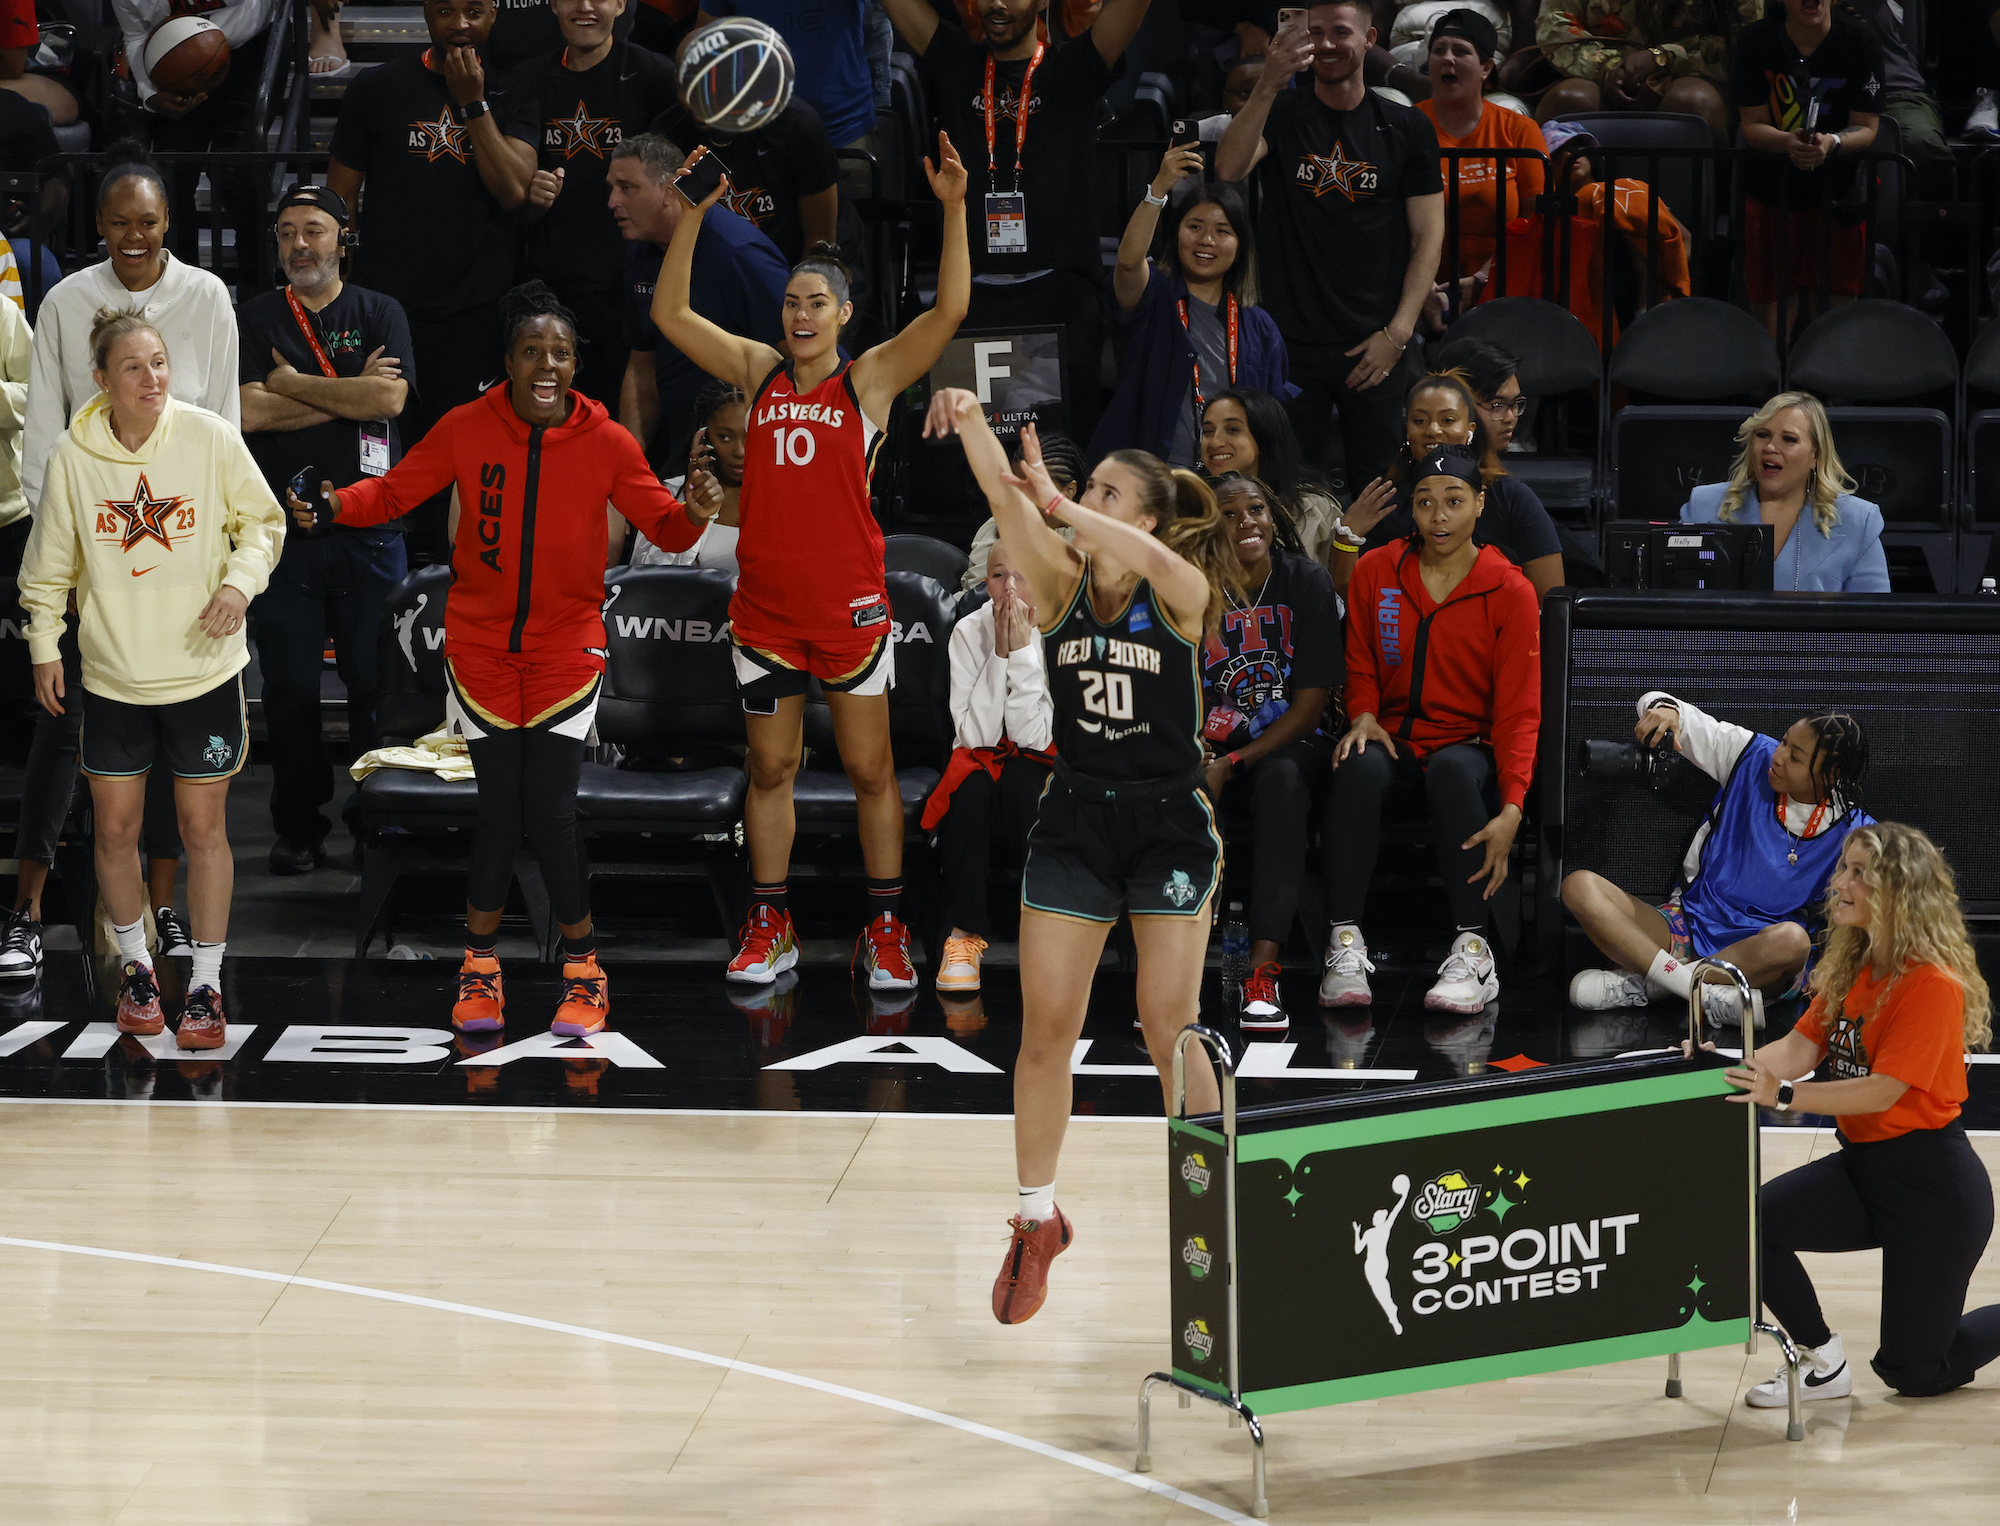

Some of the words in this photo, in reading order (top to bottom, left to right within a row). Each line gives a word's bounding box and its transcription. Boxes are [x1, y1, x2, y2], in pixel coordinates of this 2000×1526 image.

[408, 130, 427, 147] AS
[546, 129, 563, 145] AS
[605, 128, 623, 144] 23
[1297, 163, 1315, 181] AS
[1360, 172, 1378, 189] 23
[756, 195, 774, 212] 23
[974, 340, 1013, 403] F
[990, 426, 1016, 435] RENA
[1002, 412, 1038, 422] ULTRA
[773, 427, 816, 466] 10
[96, 513, 118, 534] AS
[176, 507, 195, 530] 23
[478, 462, 506, 574] ACES
[1378, 587, 1403, 666] DREAM
[1057, 636, 1092, 667] NEW
[1108, 638, 1161, 675] YORK
[1077, 670, 1134, 720] 20
[0, 1021, 667, 1069] NBA
[1836, 1058, 1869, 1077] STAR
[1181, 1155, 1211, 1191] Starry
[1413, 1183, 1479, 1220] Starry
[1183, 1238, 1212, 1274] Starry
[1412, 1242, 1449, 1284] 3
[1461, 1213, 1640, 1279] POINT
[1411, 1263, 1608, 1315] CONTEST
[1184, 1321, 1213, 1357] Starry
